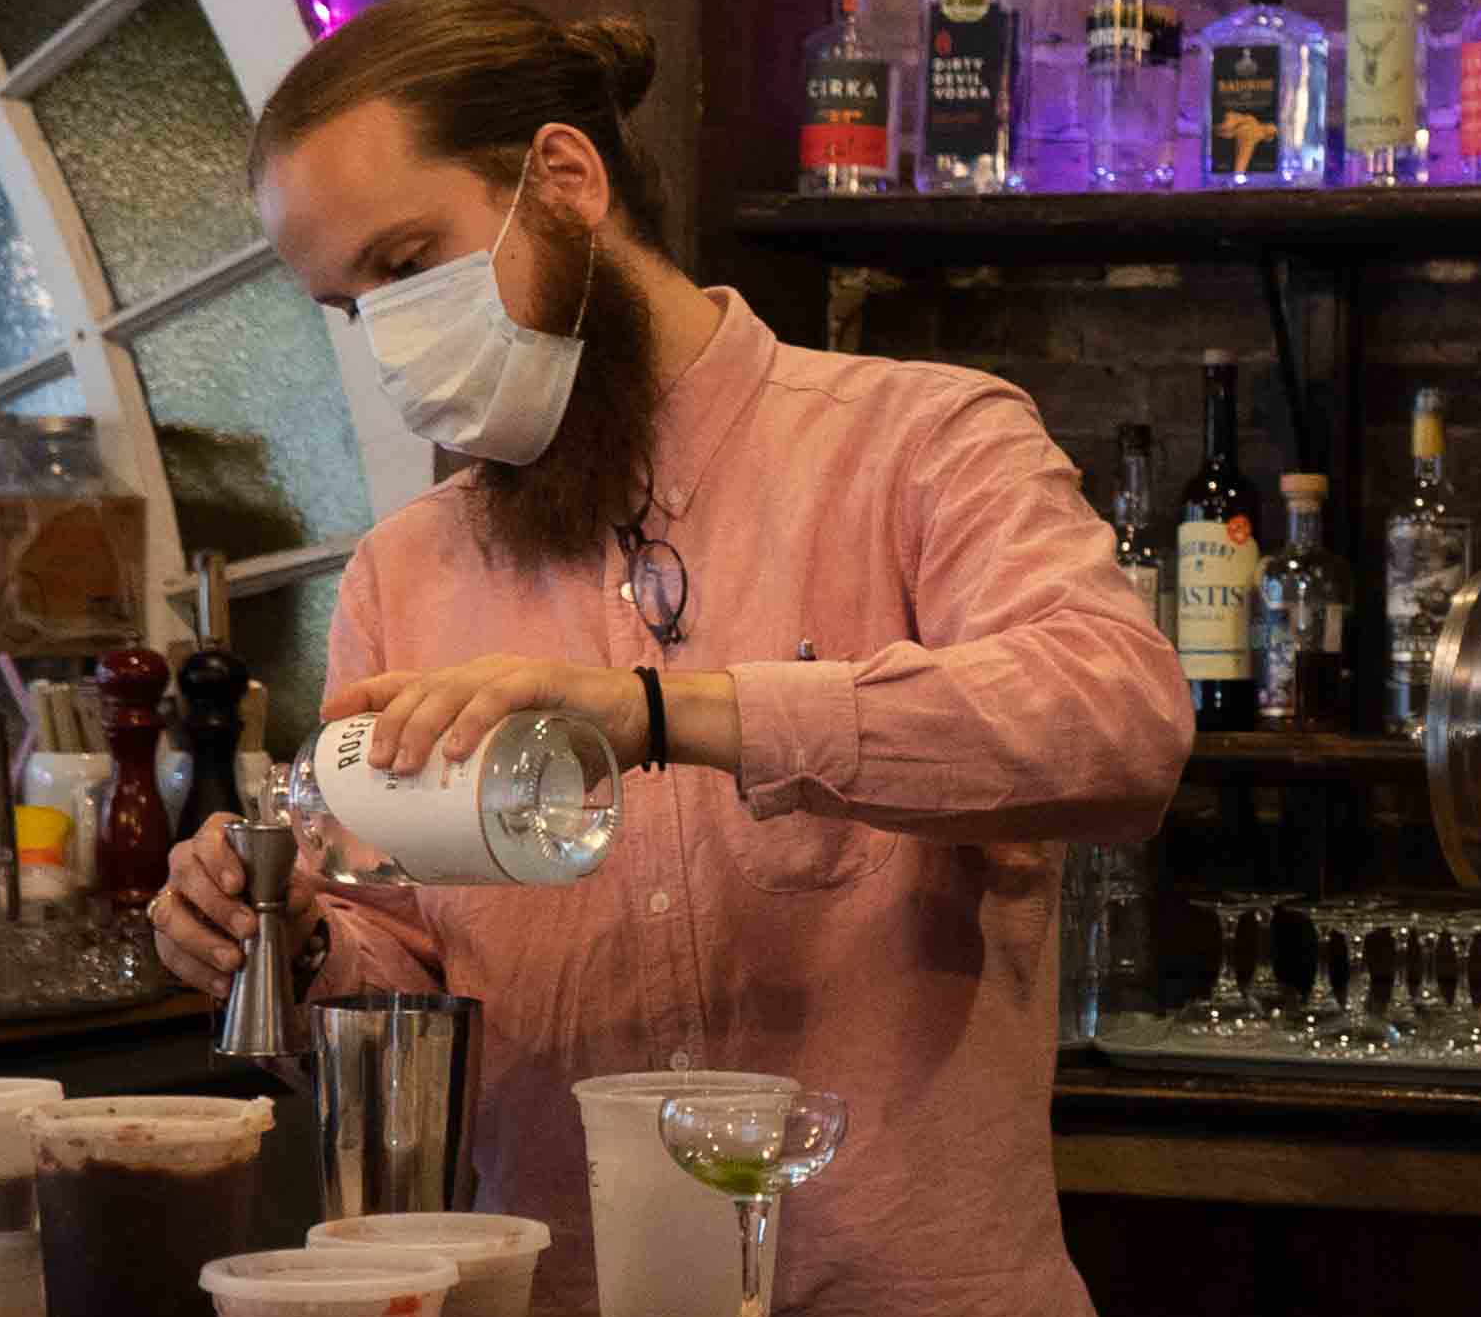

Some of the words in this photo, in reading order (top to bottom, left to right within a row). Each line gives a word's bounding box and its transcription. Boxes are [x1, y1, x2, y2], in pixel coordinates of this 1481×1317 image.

[933, 57, 985, 73] DIRTY
[806, 77, 878, 100] CIRKA
[933, 73, 983, 88] DEVIL
[933, 87, 991, 100] VODKA
[1179, 585, 1244, 610] ASTIS
[338, 713, 375, 770] ROSE
